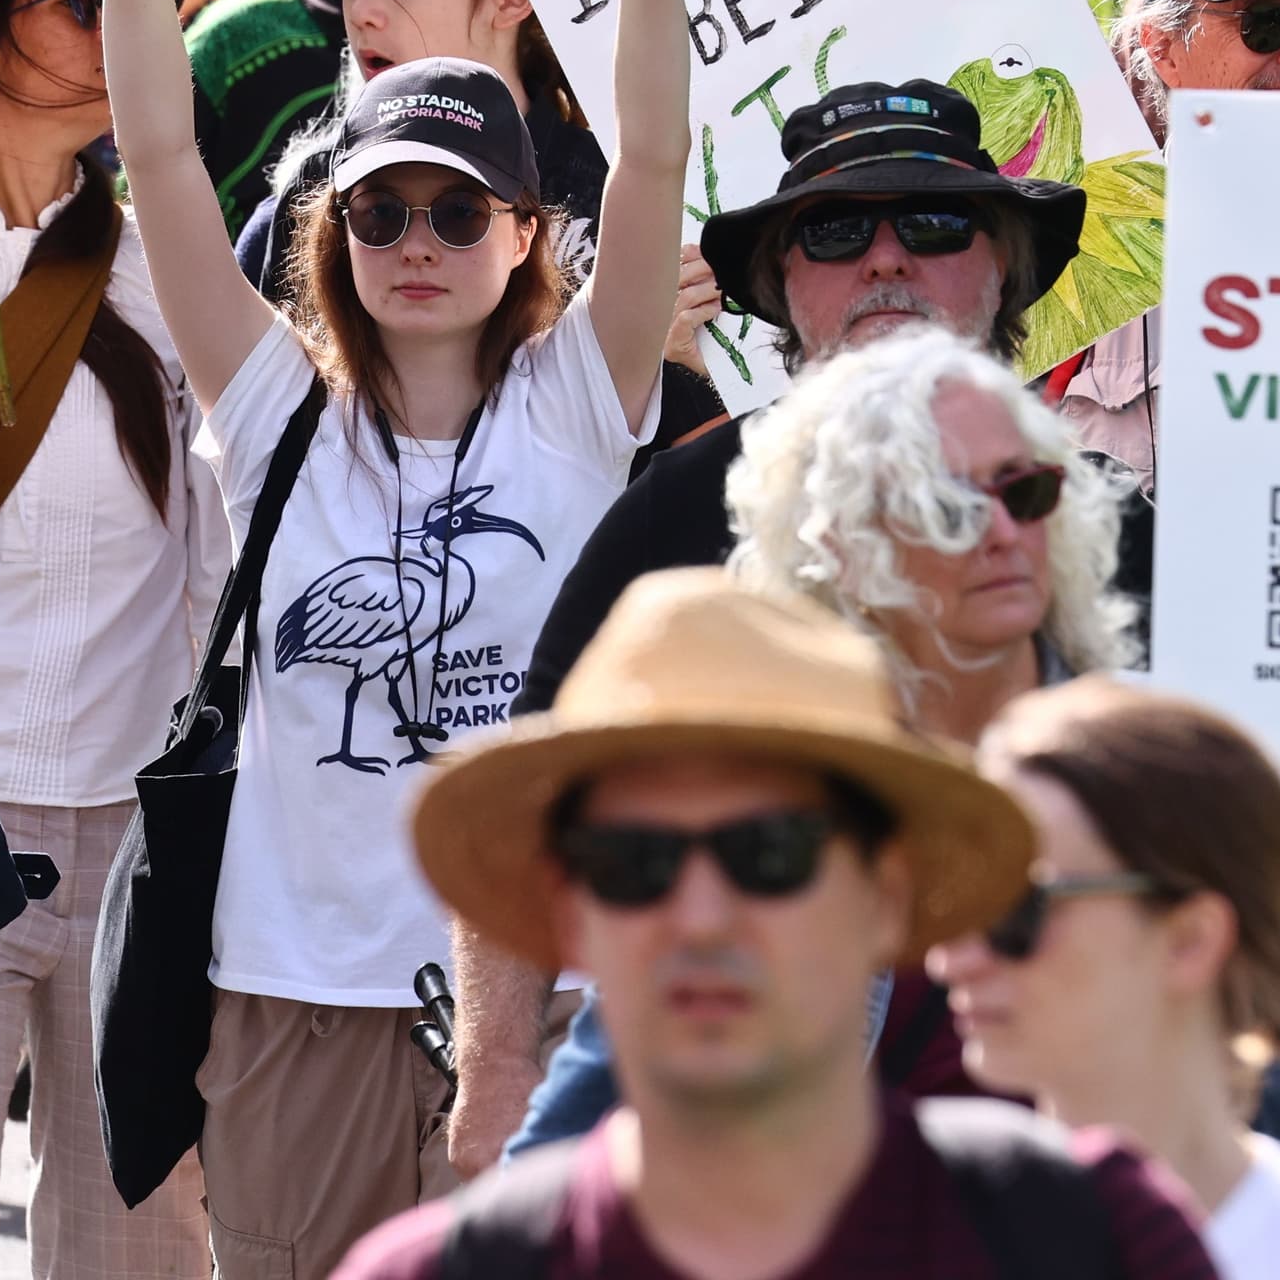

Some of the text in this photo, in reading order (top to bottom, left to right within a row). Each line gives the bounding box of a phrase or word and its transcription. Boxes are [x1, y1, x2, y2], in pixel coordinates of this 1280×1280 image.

[377, 94, 484, 122] NO STADIUM
[377, 107, 482, 132] VICTORIA PARK
[432, 645, 503, 673] SAVE
[436, 702, 508, 728] PARK
